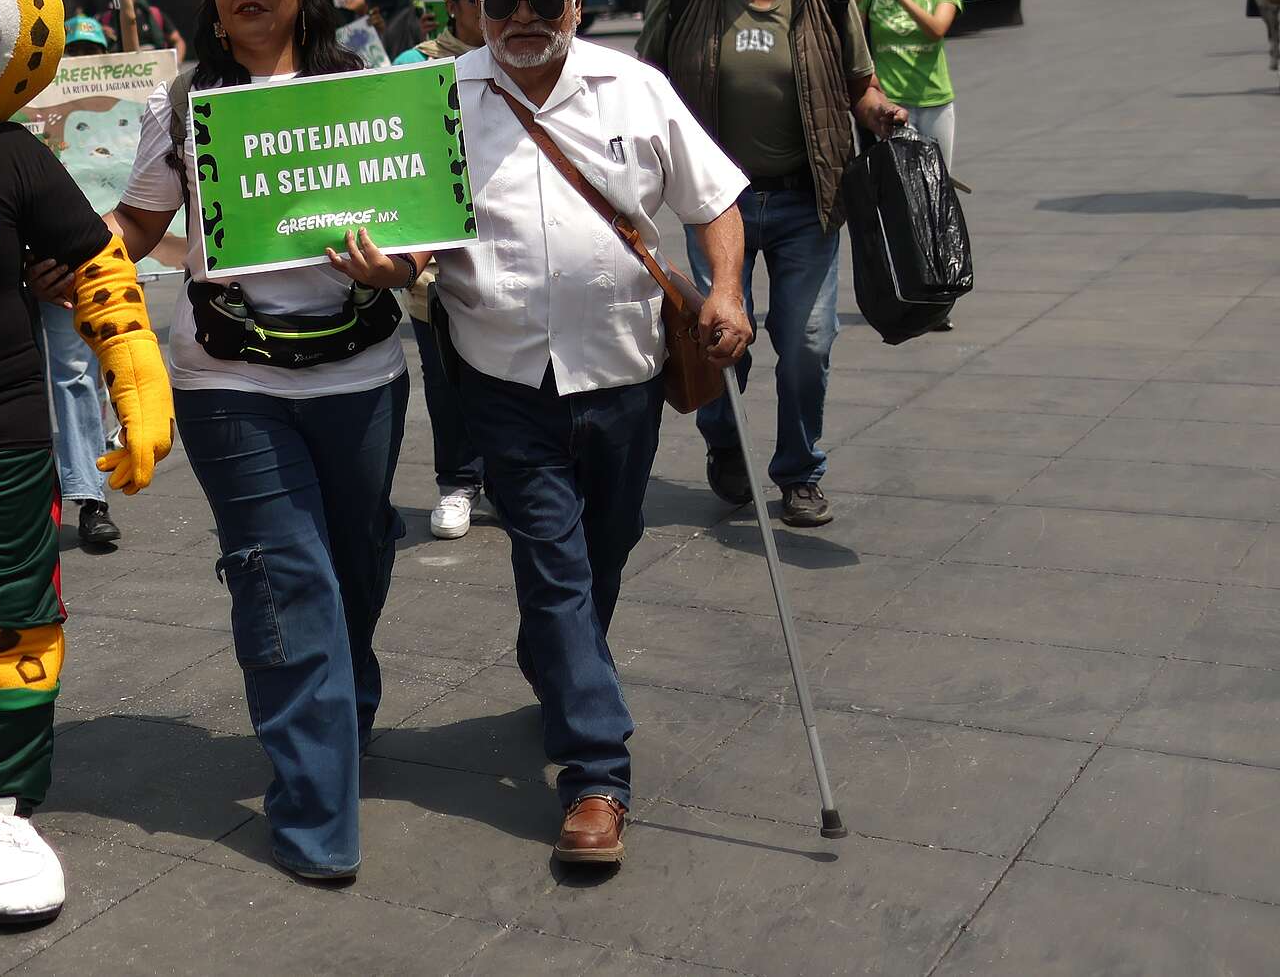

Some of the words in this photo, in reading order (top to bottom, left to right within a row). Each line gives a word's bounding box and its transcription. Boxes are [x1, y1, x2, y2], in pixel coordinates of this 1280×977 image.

[735, 29, 775, 53] GAP
[243, 116, 404, 158] PROTEJAMOS
[240, 172, 270, 199] LA
[277, 162, 351, 194] SELVA
[358, 152, 426, 184] MAYA
